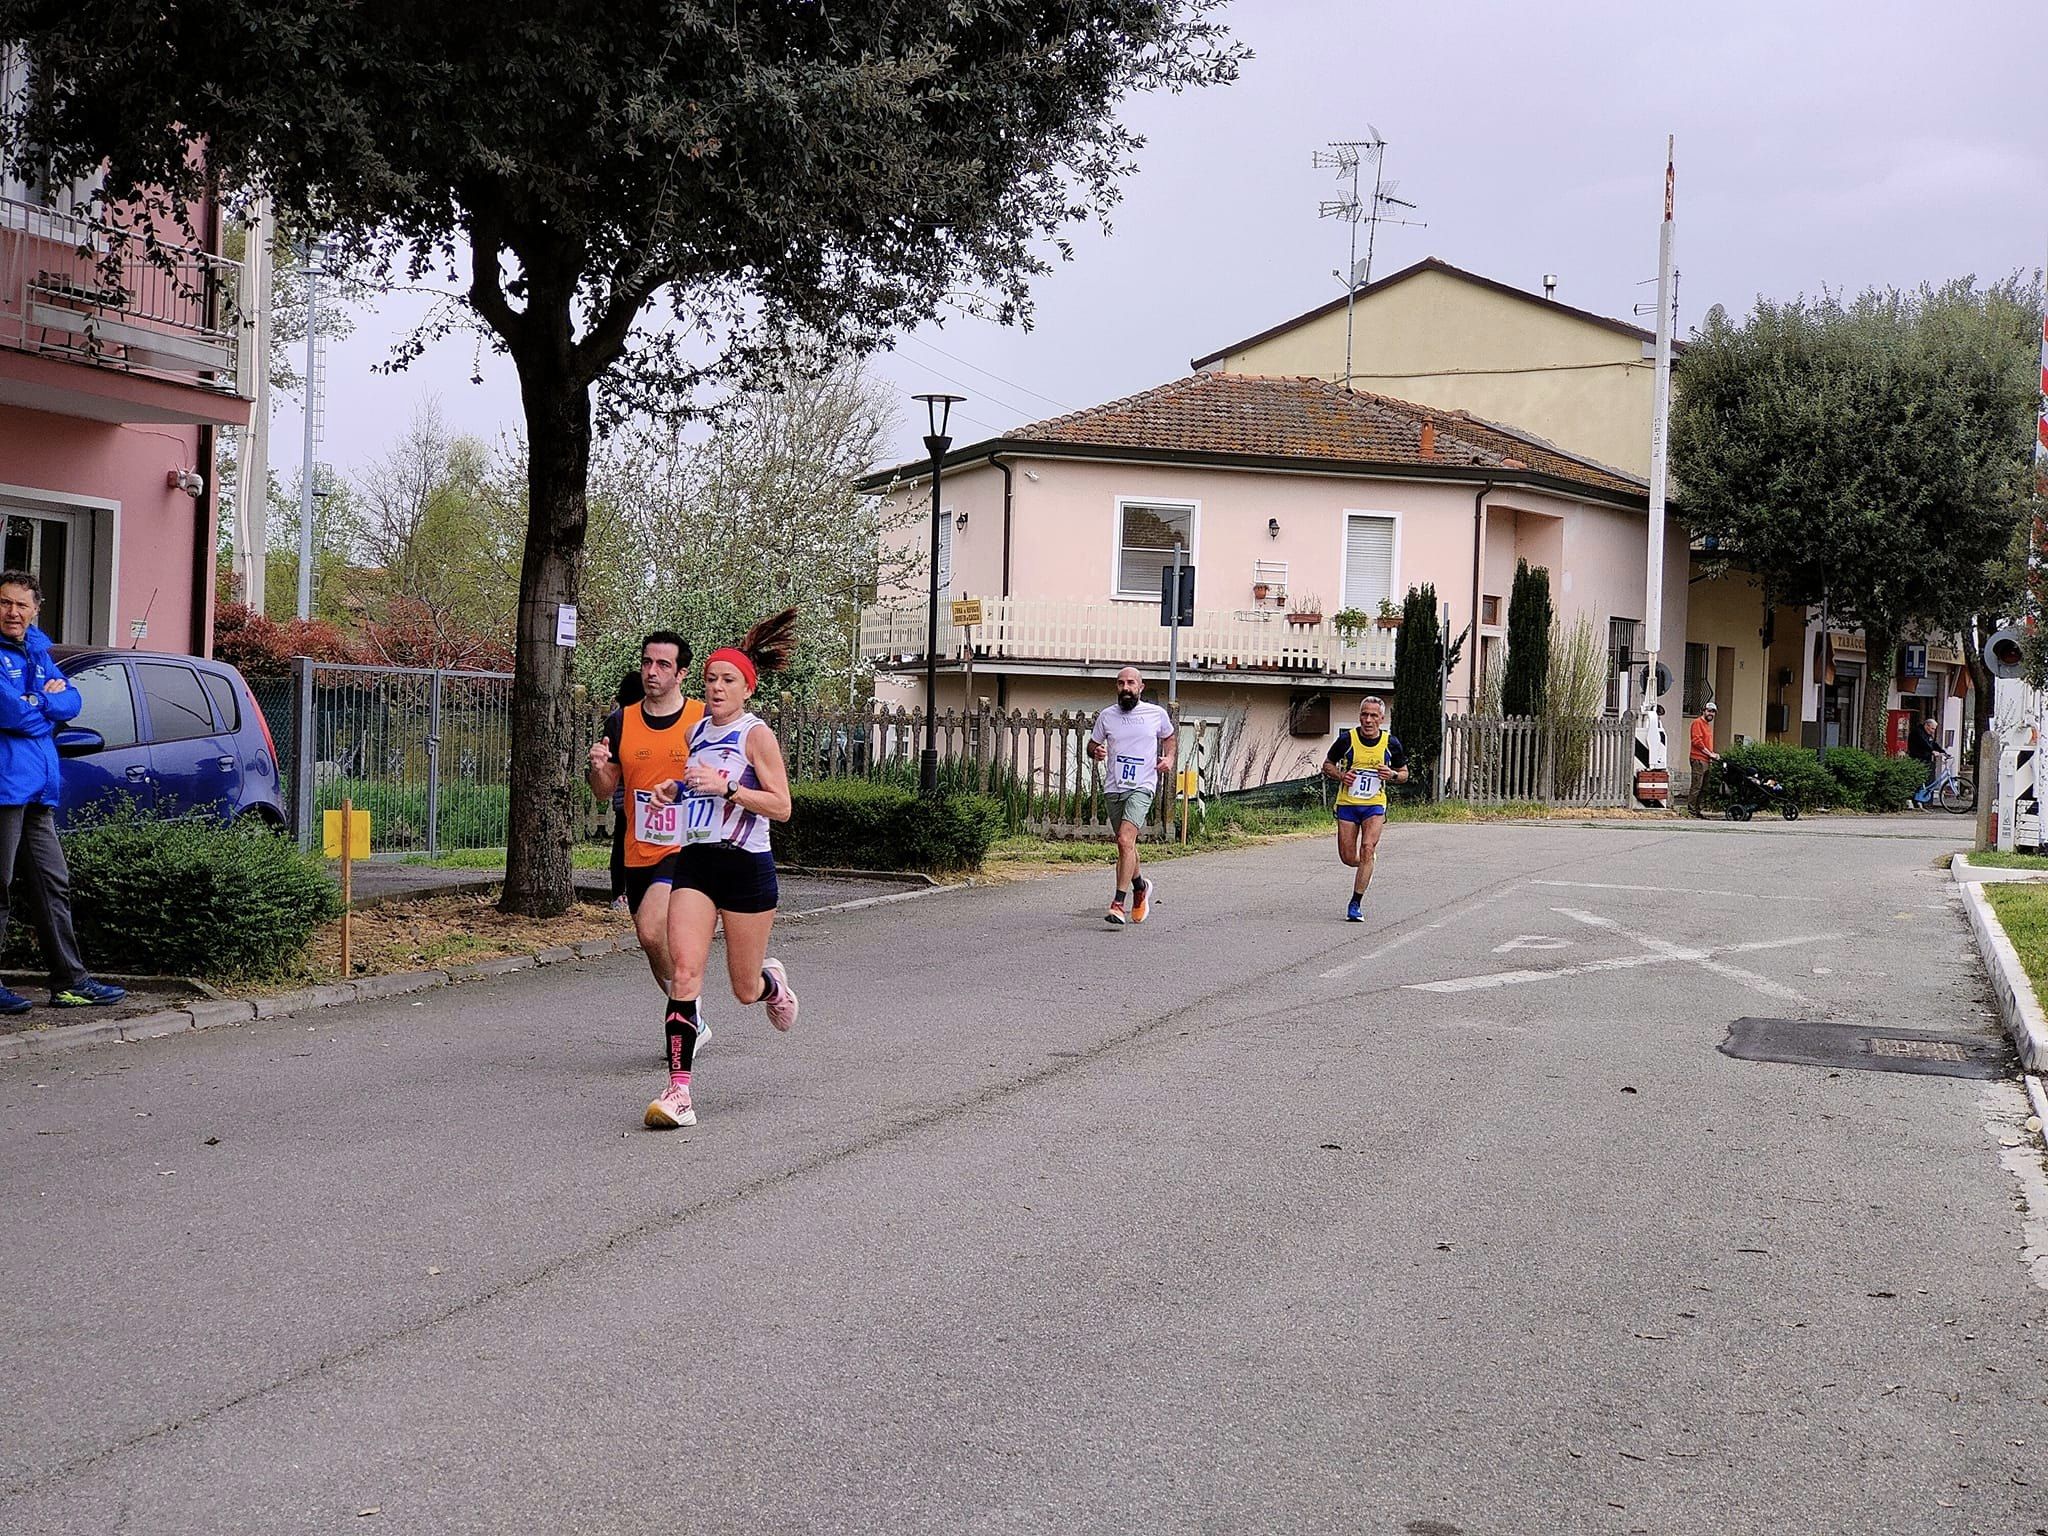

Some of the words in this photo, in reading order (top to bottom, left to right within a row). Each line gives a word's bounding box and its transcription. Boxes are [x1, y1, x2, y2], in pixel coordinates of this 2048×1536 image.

[1122, 764, 1136, 780] 64
[1359, 776, 1371, 791] 51
[644, 804, 676, 832] 259
[688, 799, 715, 828] 177
